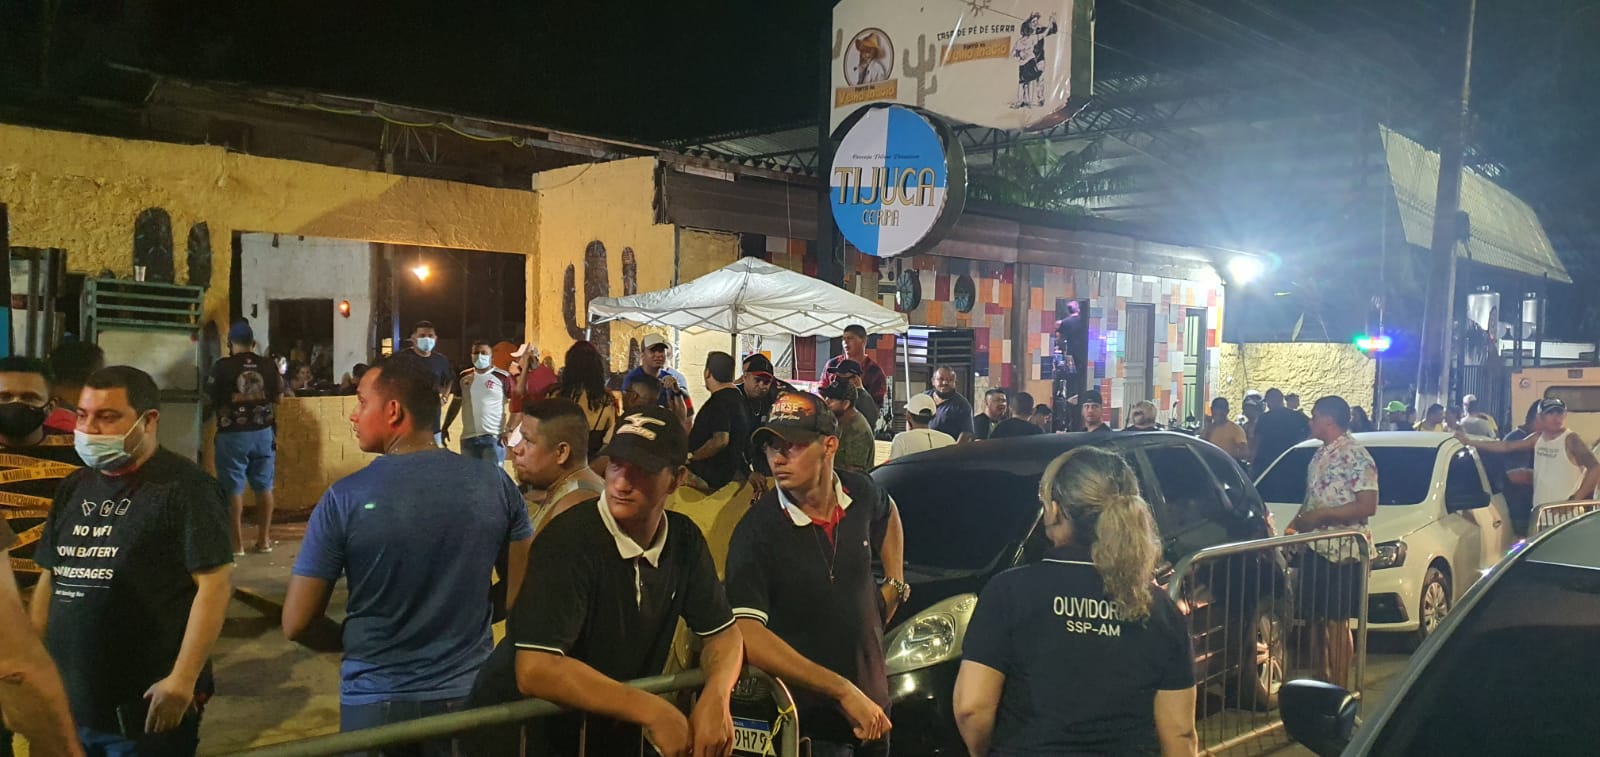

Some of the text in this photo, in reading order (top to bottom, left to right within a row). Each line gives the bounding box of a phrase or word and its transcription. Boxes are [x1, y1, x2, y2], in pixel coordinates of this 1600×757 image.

[980, 25, 989, 34] DE
[991, 24, 1015, 35] SERRA
[834, 166, 937, 207] TIJUCA
[862, 209, 900, 226] CERPA
[72, 525, 90, 537] NO
[1053, 596, 1120, 620] OUVIDOR
[1066, 620, 1121, 637] SSP-AM
[734, 729, 769, 751] 9H79
